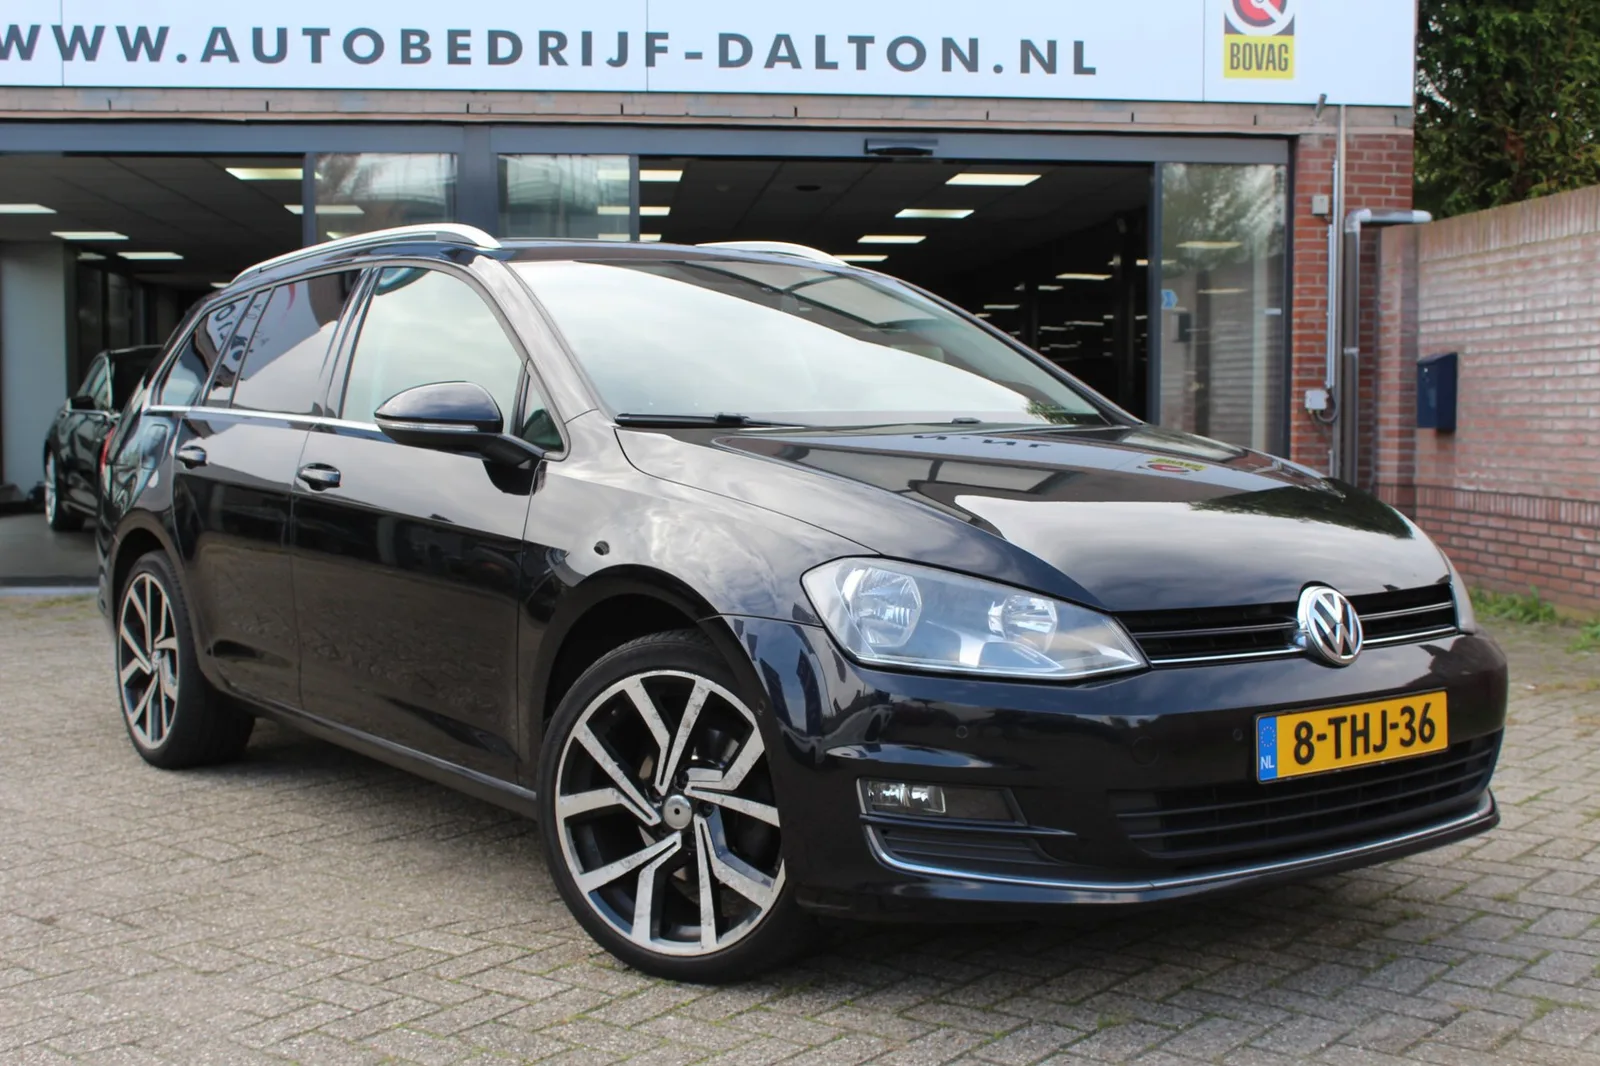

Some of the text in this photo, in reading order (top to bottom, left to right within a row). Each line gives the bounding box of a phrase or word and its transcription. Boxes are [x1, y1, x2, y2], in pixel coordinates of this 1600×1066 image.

[0, 24, 1097, 75] WWW.AUTOBEDRIJF-DALTON.NL
[1229, 42, 1289, 72] BOVAG
[1293, 702, 1436, 766] 8-THJ-36
[1260, 755, 1275, 770] NL
